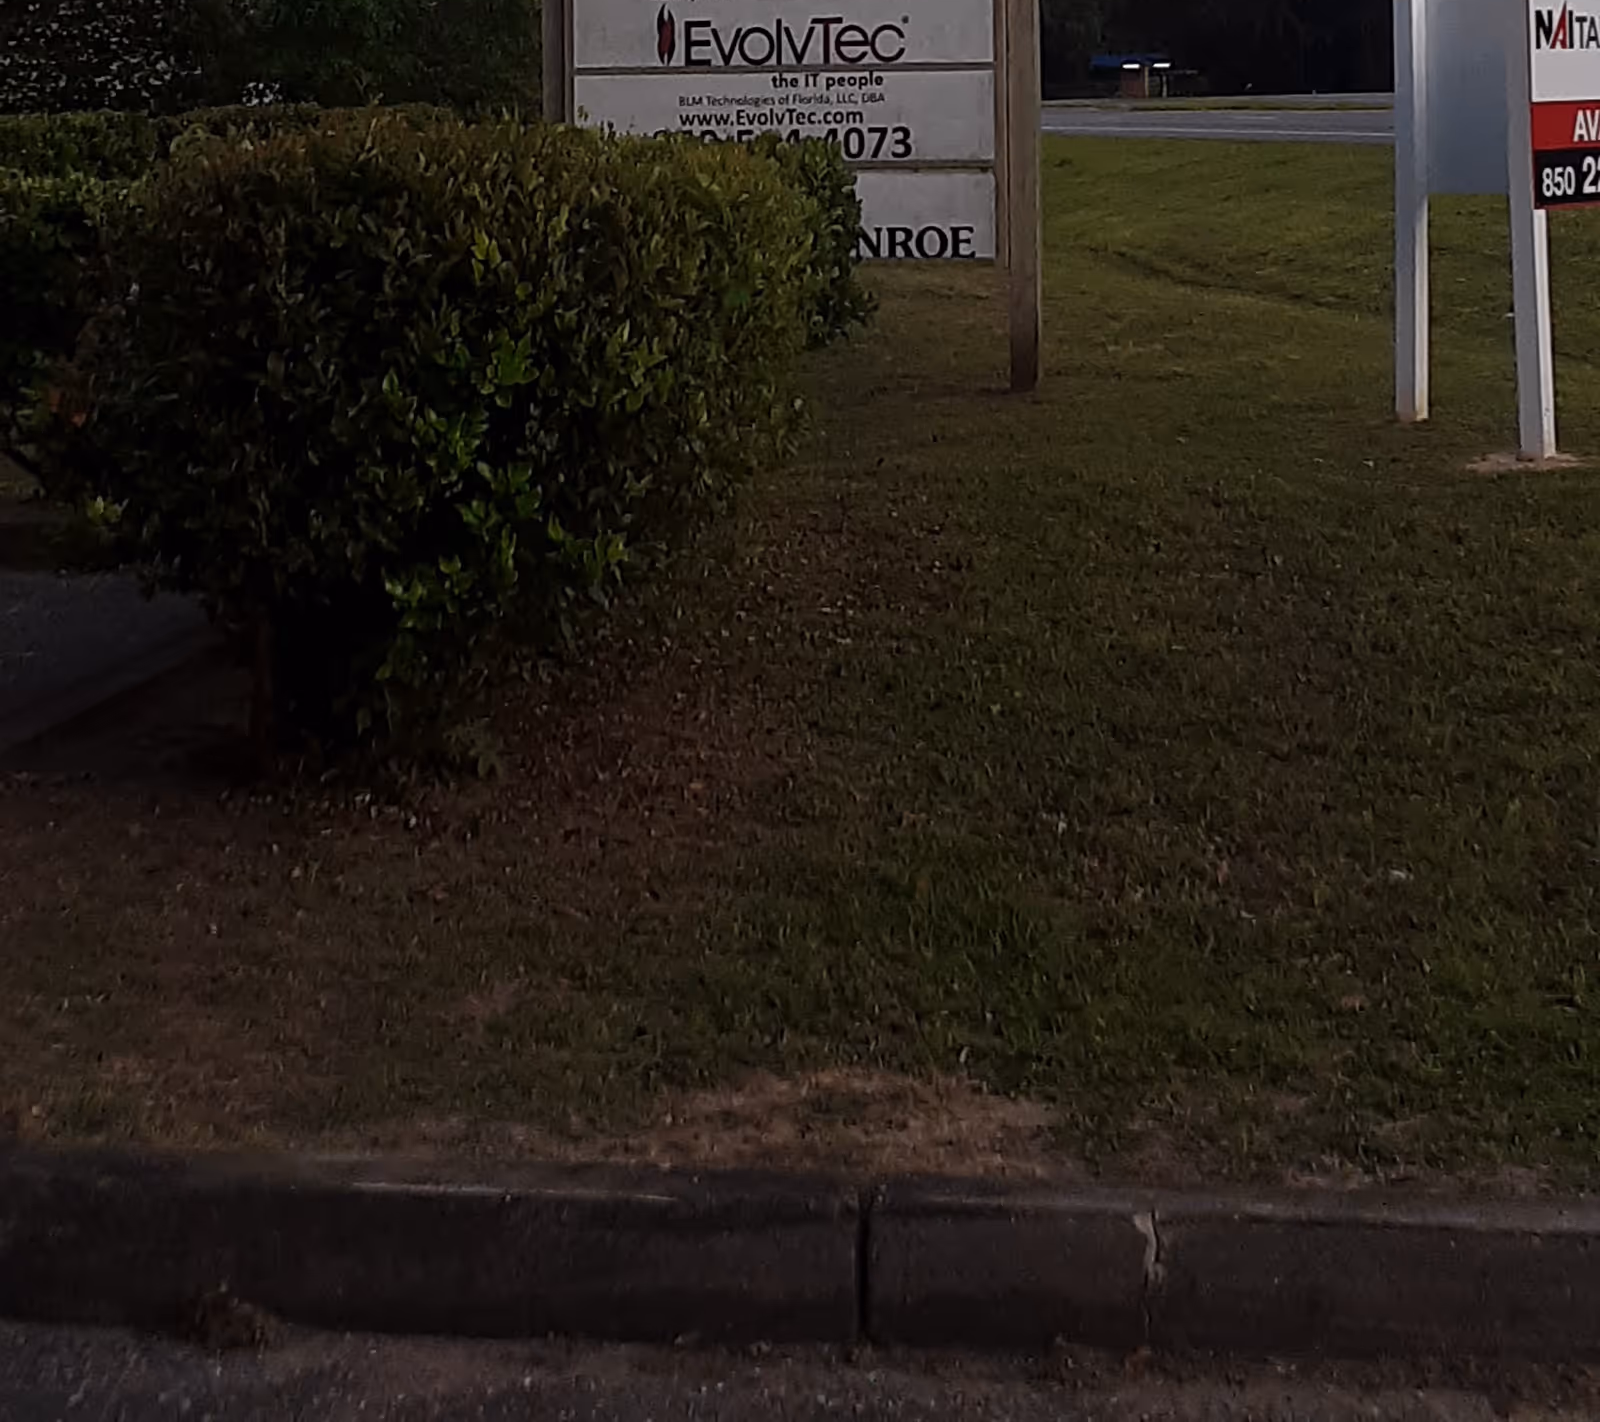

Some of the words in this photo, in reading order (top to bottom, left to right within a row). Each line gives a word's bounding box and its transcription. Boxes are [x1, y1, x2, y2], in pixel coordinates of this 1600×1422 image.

[771, 73, 799, 89] the
[804, 73, 820, 88] IT
[826, 71, 884, 91] people
[706, 94, 776, 108] Technologies
[778, 93, 790, 105] of
[679, 108, 864, 127] www.EvolvTec.com
[1573, 109, 1600, 142] AV
[1542, 166, 1576, 197] 850
[1582, 155, 1600, 195] 2
